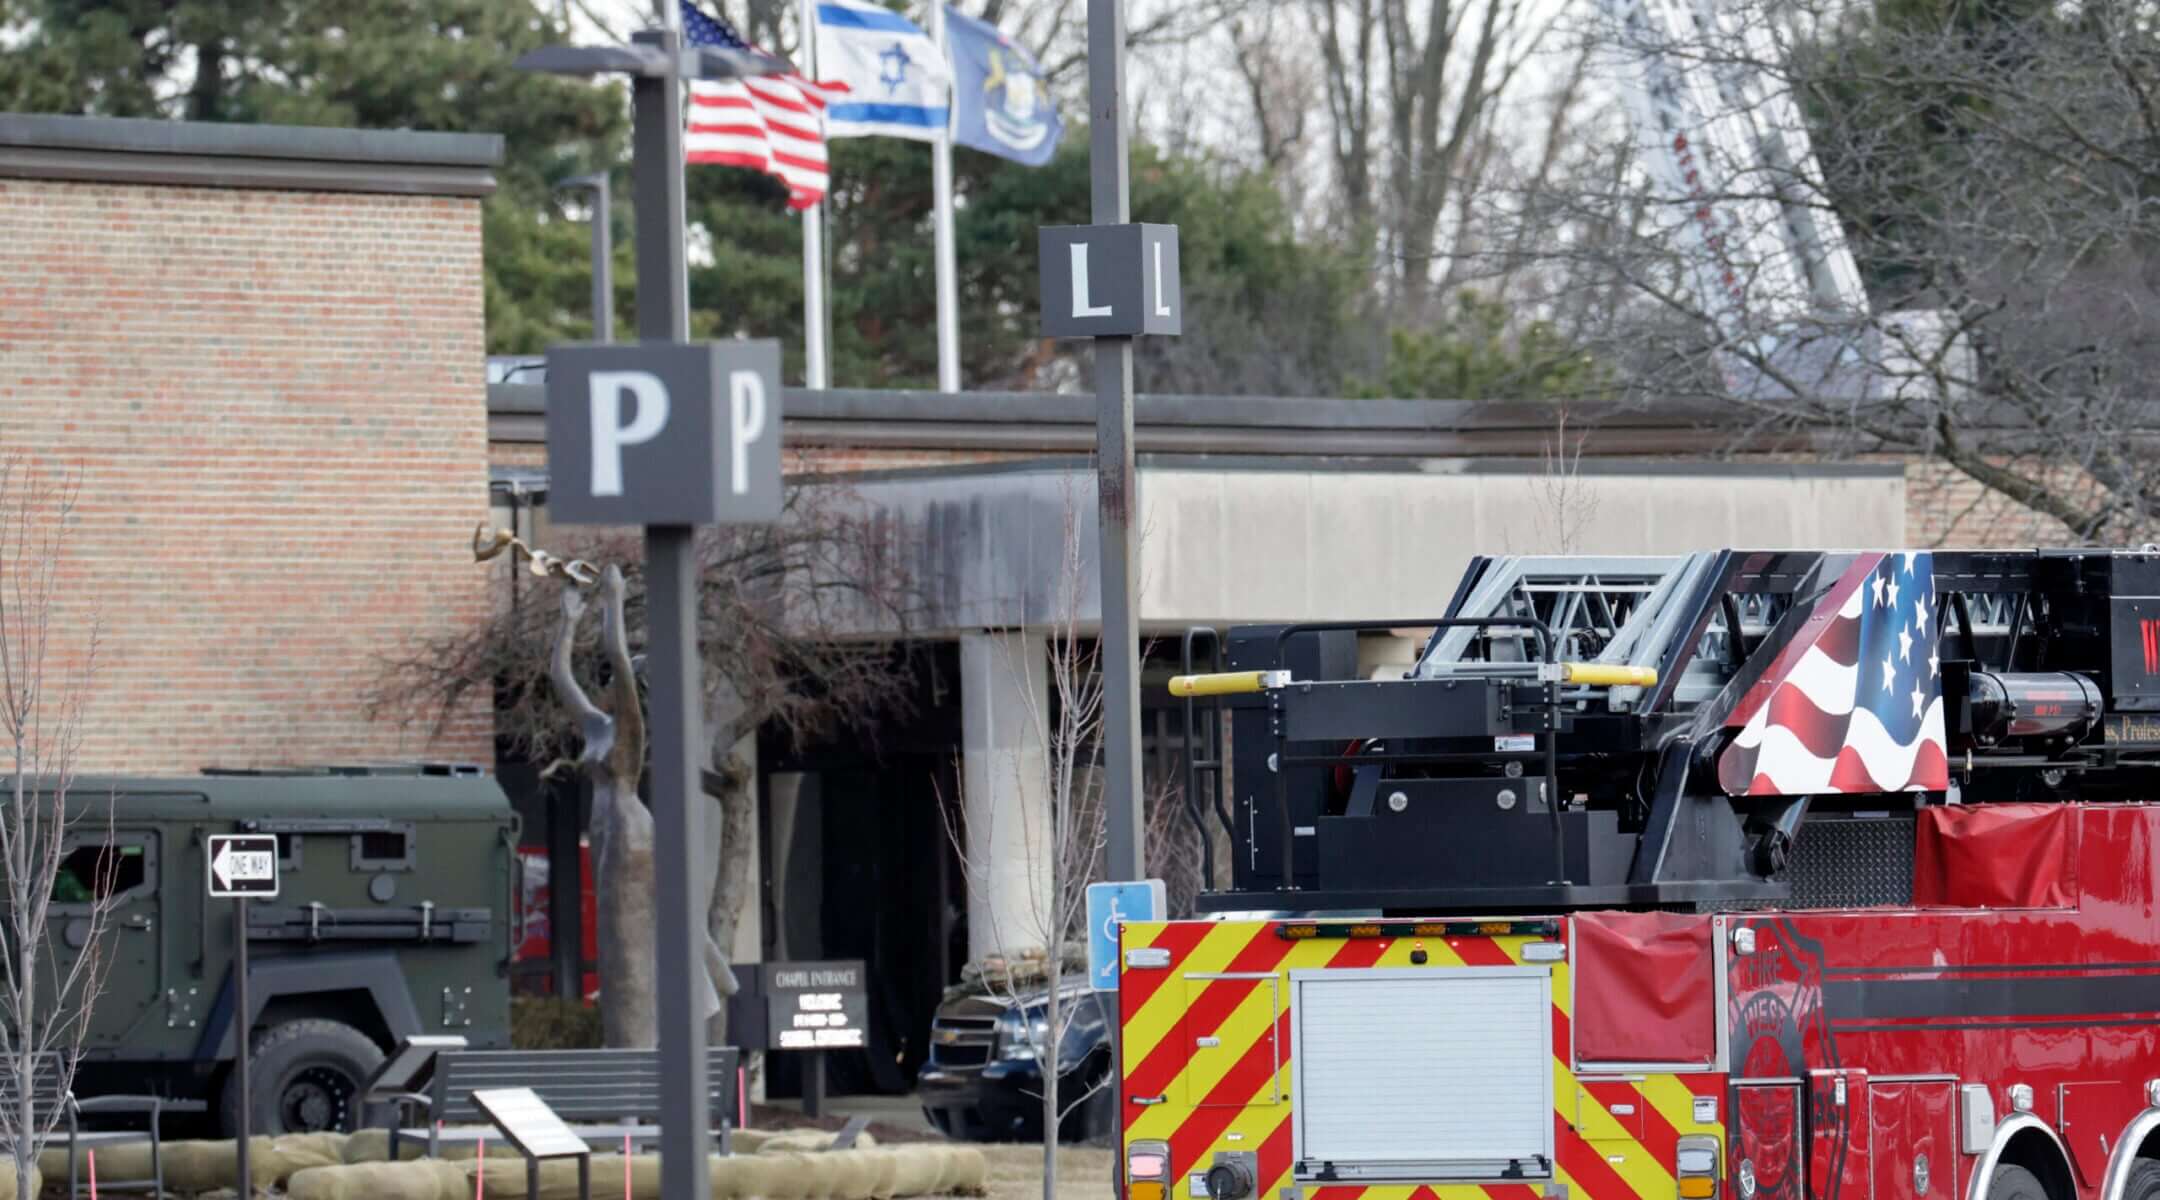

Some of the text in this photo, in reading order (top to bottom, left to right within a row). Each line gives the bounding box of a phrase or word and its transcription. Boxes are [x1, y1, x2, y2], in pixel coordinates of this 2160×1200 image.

[1070, 242, 1113, 318] L
[1154, 241, 1171, 317] L
[588, 370, 672, 497] P
[729, 370, 767, 496] P
[231, 855, 270, 875] ONE WAY
[776, 969, 857, 988] CHAPEL ENTRANCE
[1745, 951, 1785, 987] FIRE
[1744, 998, 1788, 1041] WEST
